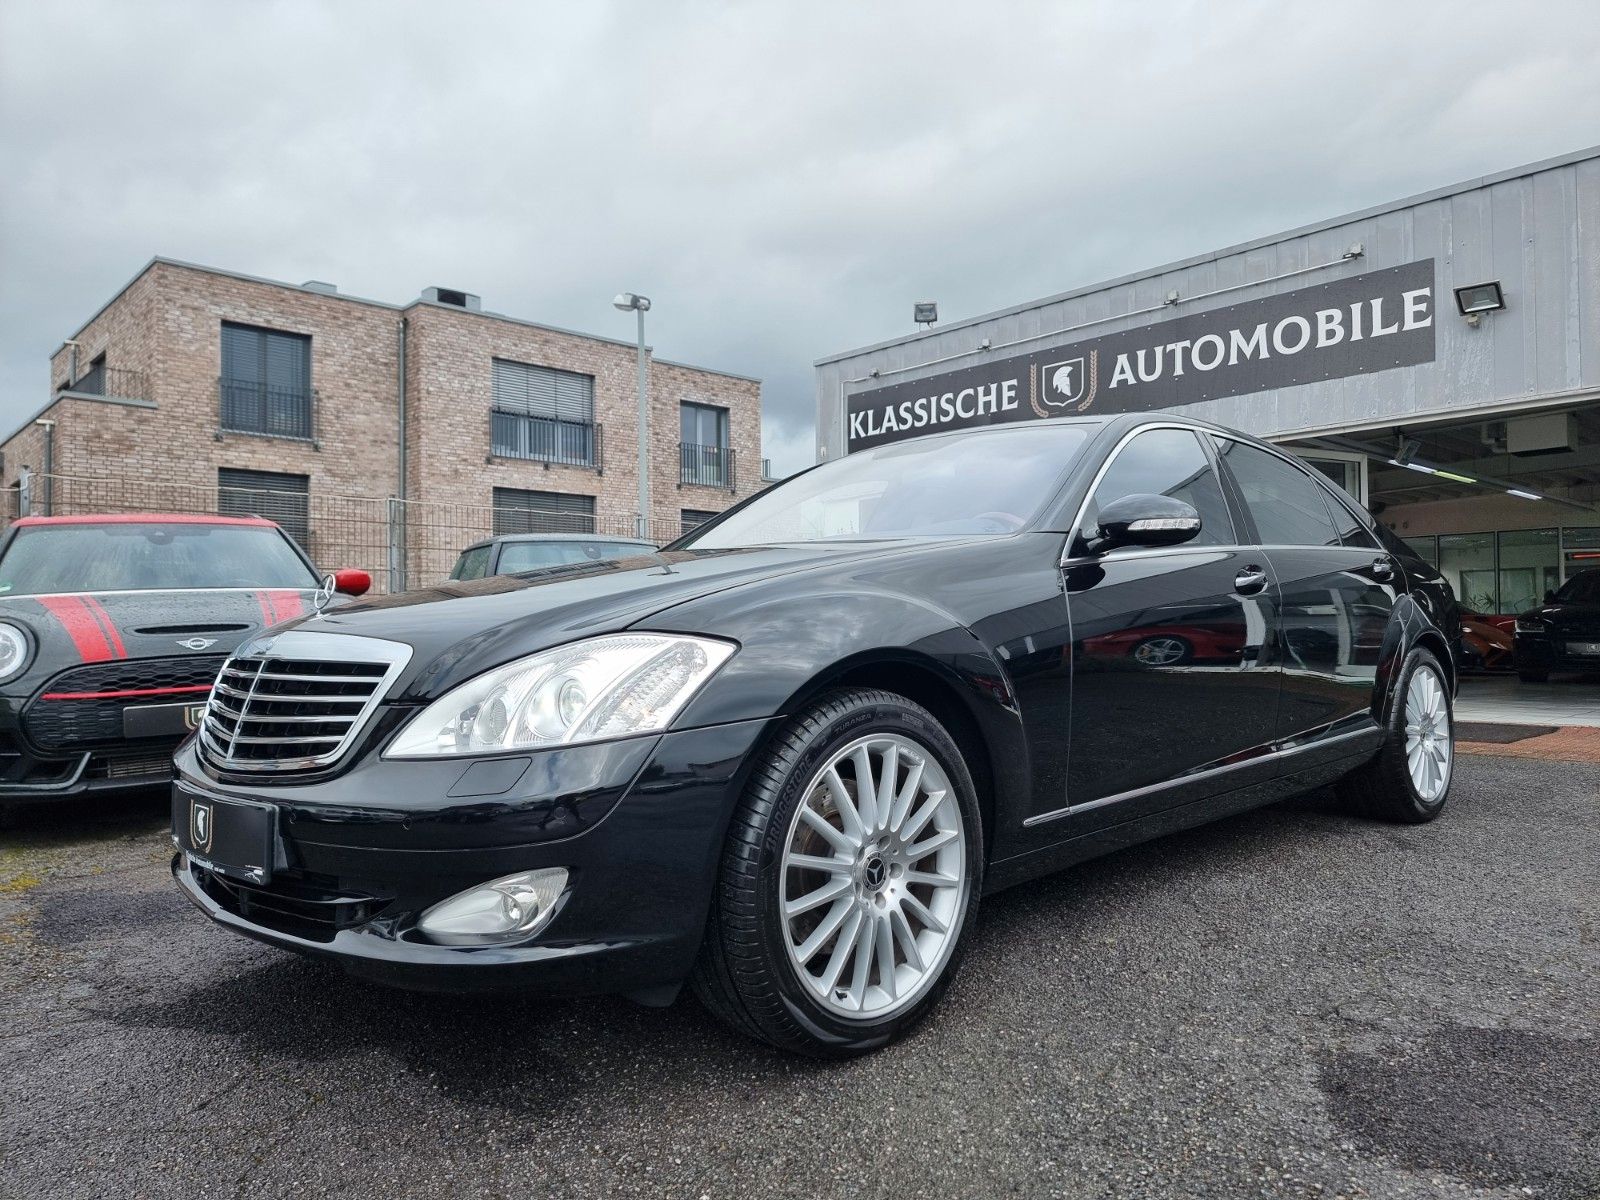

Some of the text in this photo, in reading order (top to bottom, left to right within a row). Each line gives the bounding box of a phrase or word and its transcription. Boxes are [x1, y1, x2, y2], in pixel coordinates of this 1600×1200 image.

[850, 287, 1432, 439] KLASSISCHE AUTOMOBILE
[764, 753, 813, 852] BRIDGESTONE
